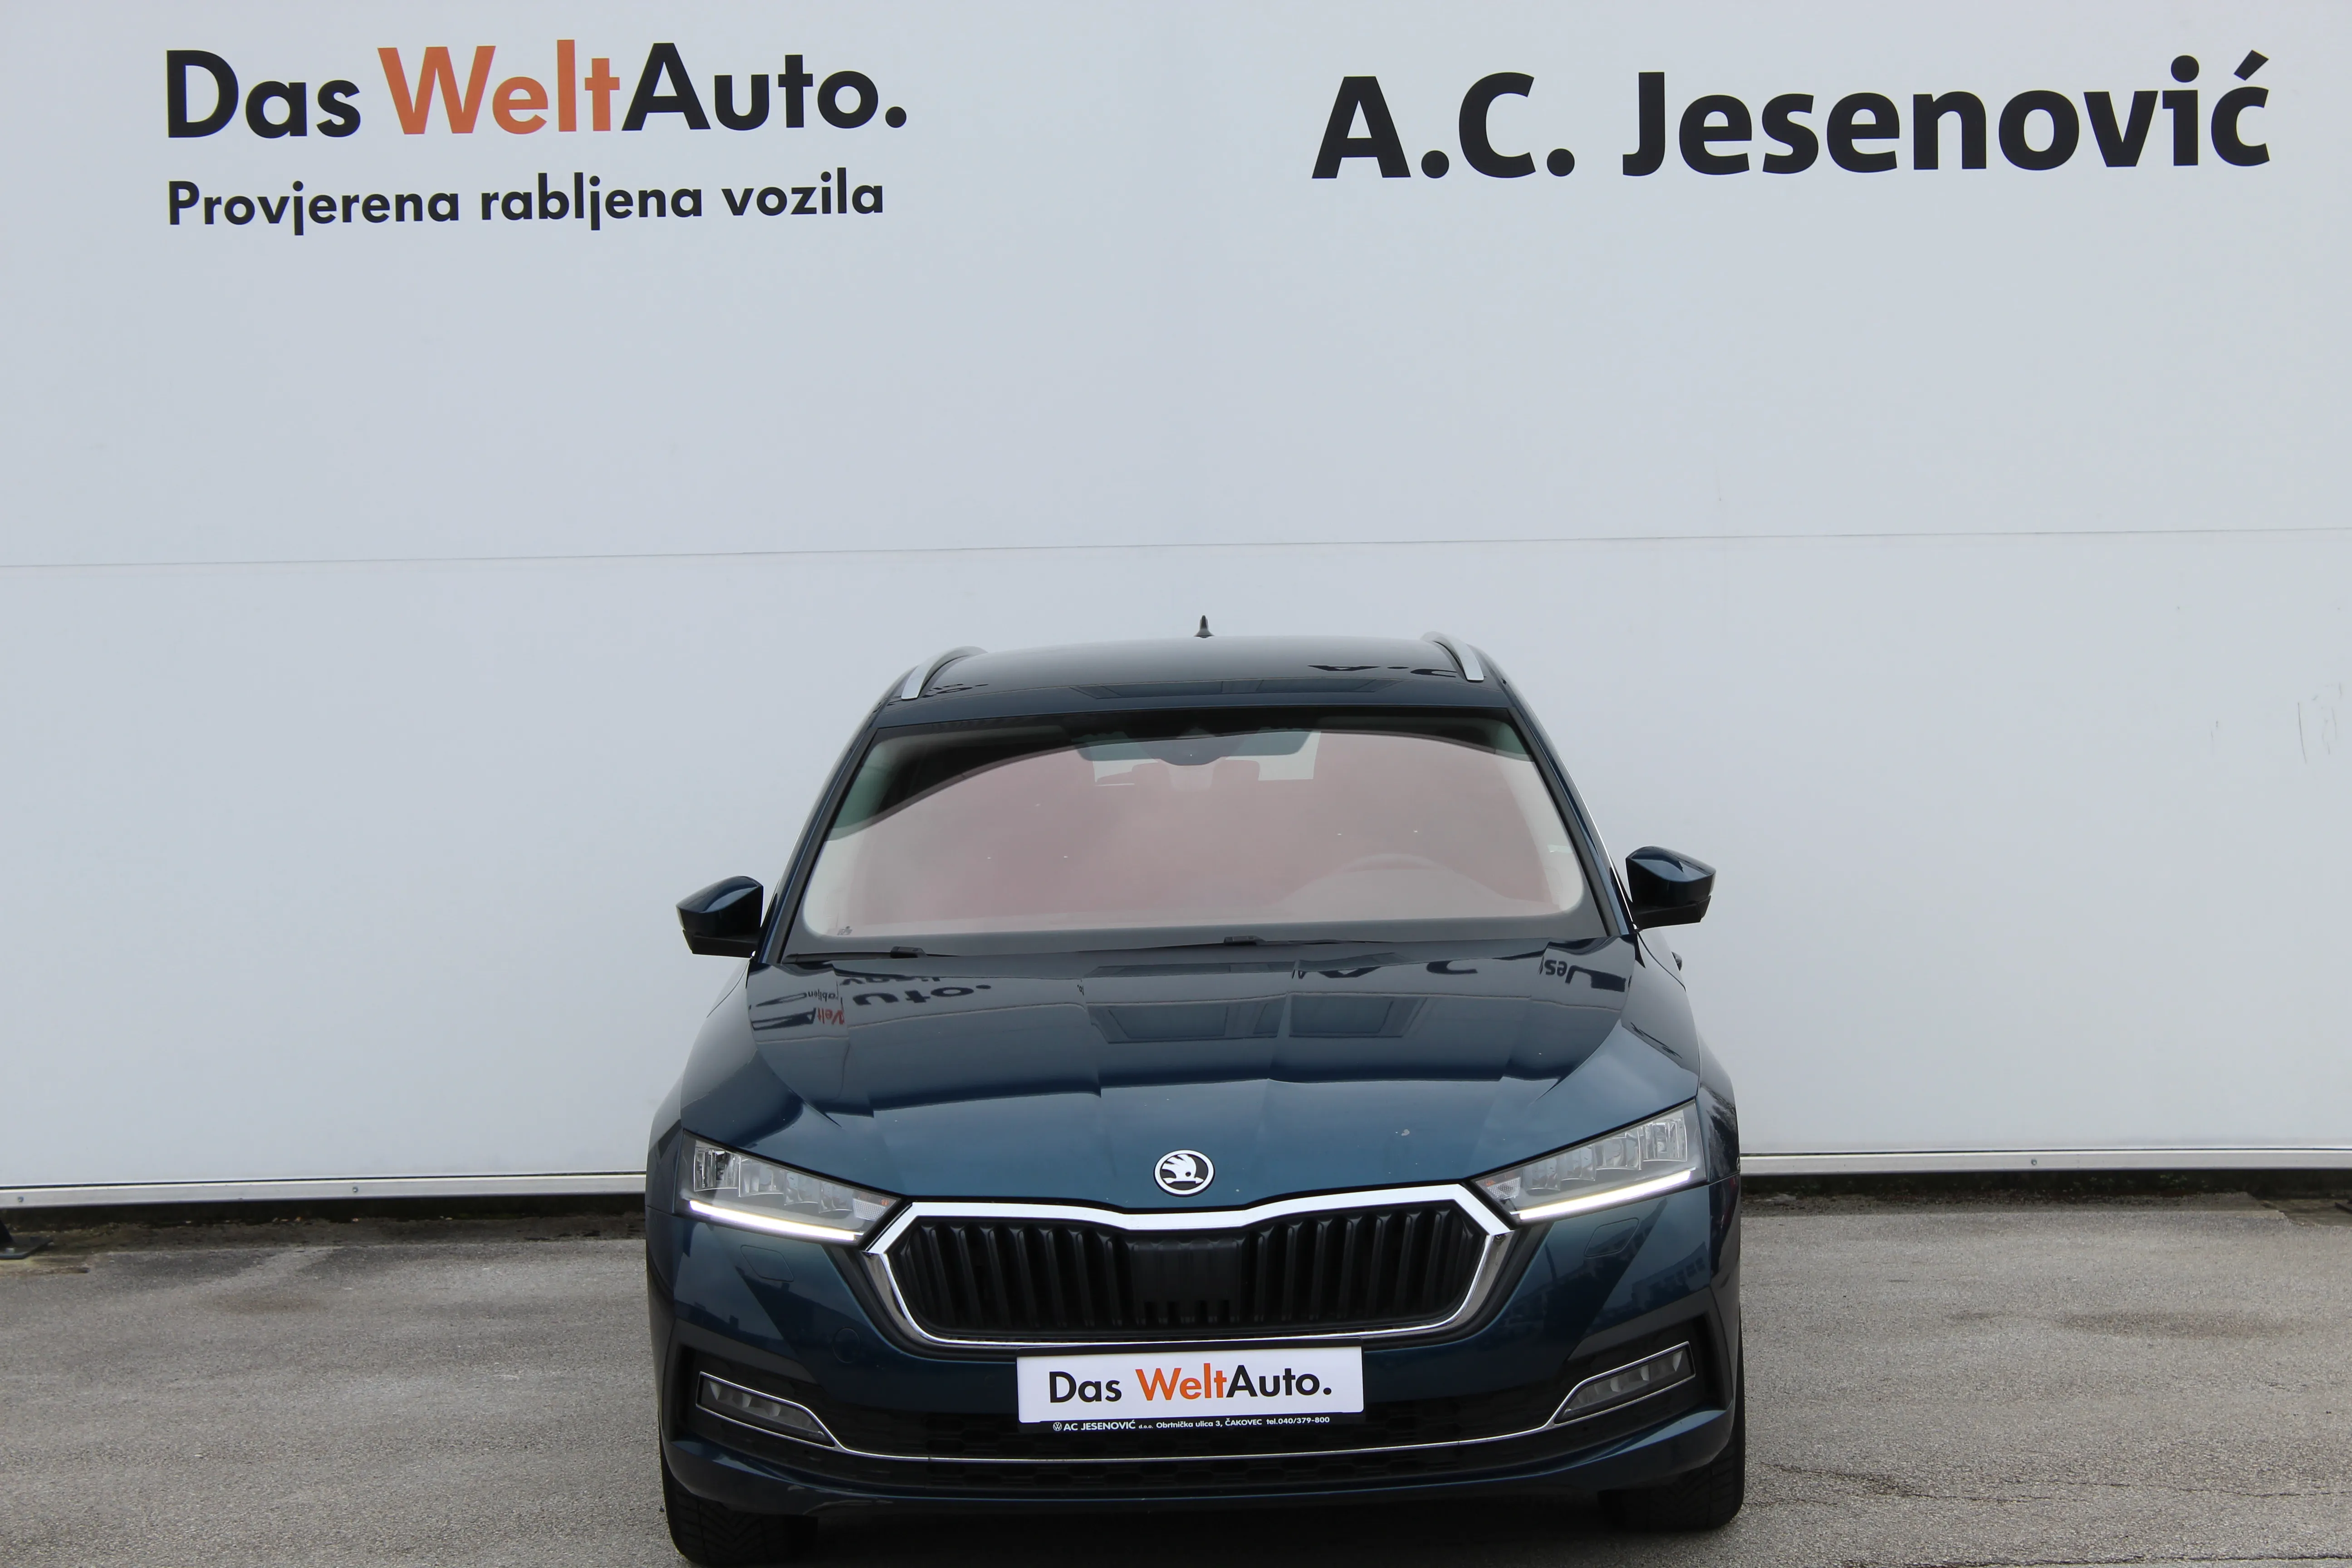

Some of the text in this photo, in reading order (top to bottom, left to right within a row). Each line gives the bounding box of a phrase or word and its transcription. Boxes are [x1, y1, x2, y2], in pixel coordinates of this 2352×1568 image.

[167, 39, 907, 139] Das WeltAuto.
[1312, 50, 2270, 179] A.C. Jesenović
[169, 167, 883, 236] Provjerena rabljena vozila
[1049, 1362, 1332, 1403] Das WeltAuto.
[1063, 1423, 1078, 1431] AC
[1081, 1420, 1136, 1430] JESENOVIĆ
[1225, 1418, 1262, 1426] ČAKOVEC
[1266, 1416, 1330, 1425] tel.040/379-800
